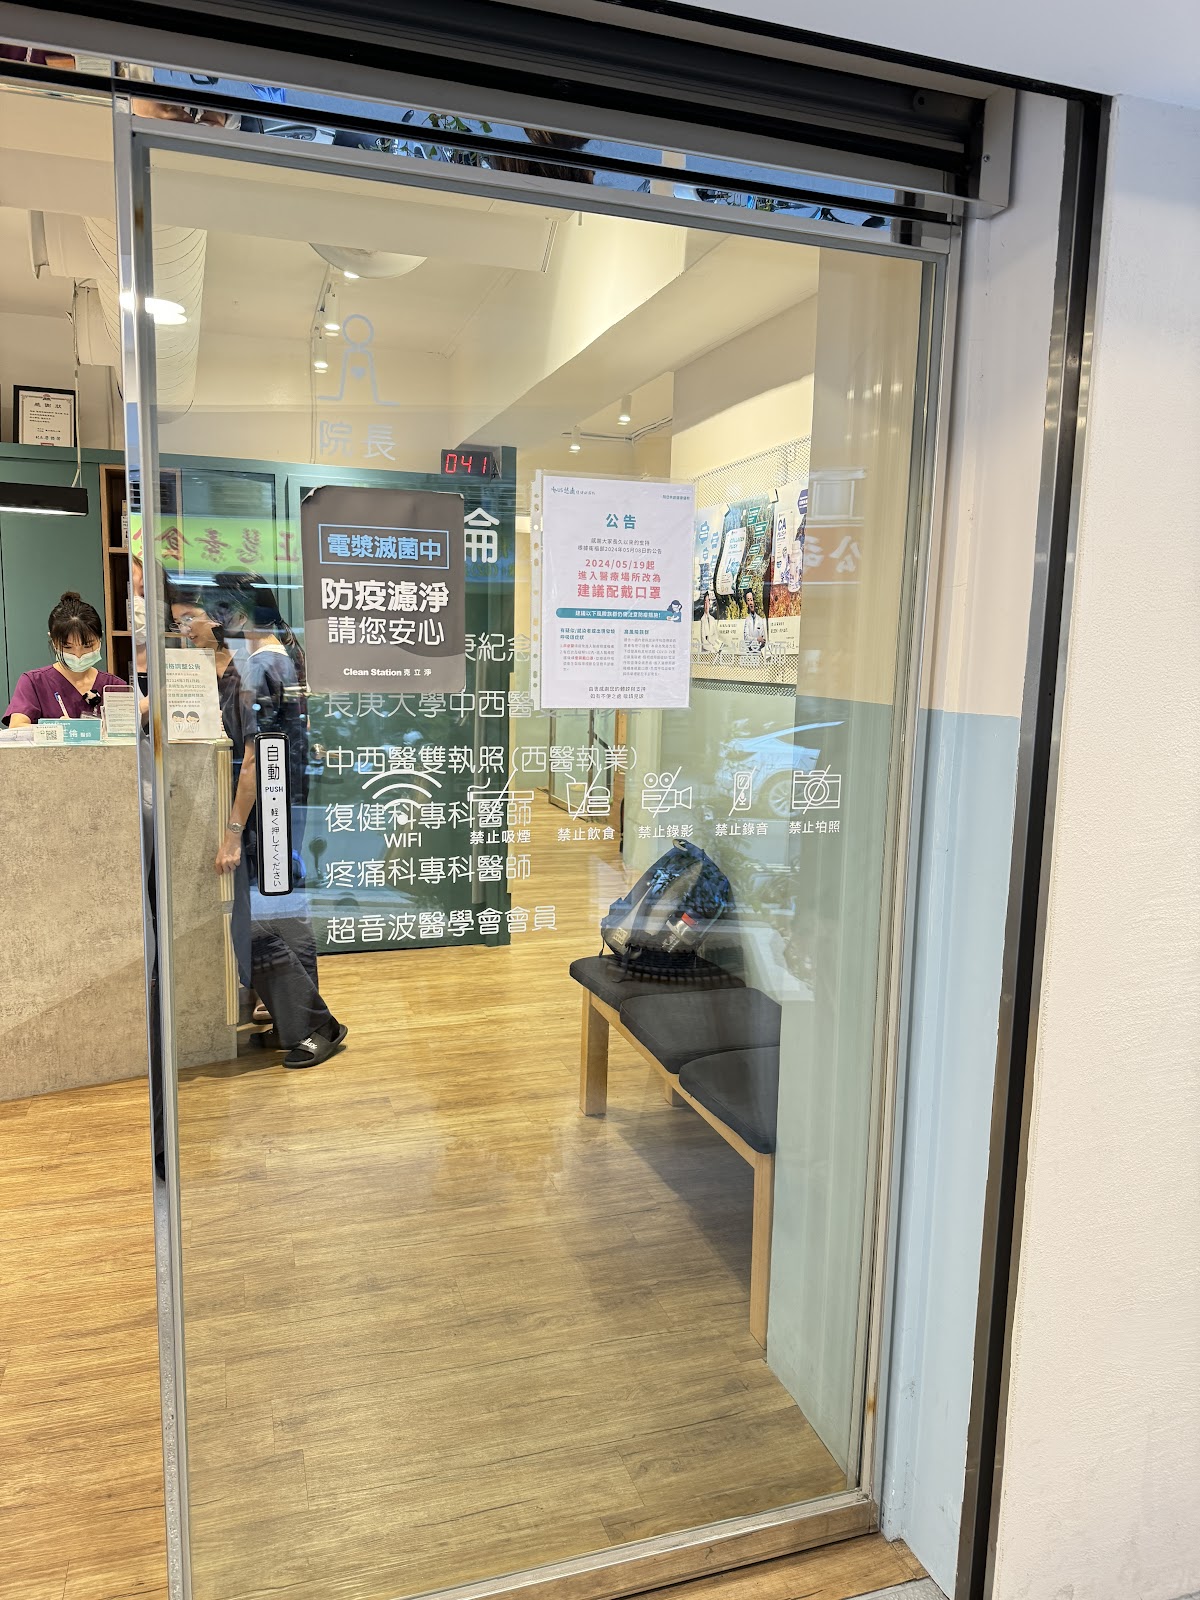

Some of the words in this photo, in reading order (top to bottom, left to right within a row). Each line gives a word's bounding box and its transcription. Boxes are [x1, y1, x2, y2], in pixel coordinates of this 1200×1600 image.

[319, 420, 396, 461] 院長
[445, 453, 488, 474] 041
[605, 513, 637, 530] 公告
[327, 533, 441, 562] 電漿滅菌中
[585, 558, 655, 571] 2024/05/19起
[577, 570, 661, 583] 進入醫療場所改為
[320, 578, 449, 613] 防疫濾淨
[577, 583, 661, 600] 建議配戴口罩
[327, 616, 445, 646] 請您安心
[343, 668, 369, 676] Clean
[370, 668, 402, 677] Station
[267, 744, 280, 781] 自動
[326, 745, 637, 776] 中西醫雙執照(西醫執業)
[325, 799, 532, 834] 復健科專科醫師
[384, 832, 422, 848] WIFI
[469, 829, 532, 845] 禁止吸煙
[557, 826, 616, 842] 禁止飲食
[638, 823, 694, 839] 禁止錄影
[715, 822, 769, 837] 禁止錄音
[271, 807, 282, 887] 軽く押してください
[325, 853, 532, 889] 疼痛科專科醫師
[325, 905, 558, 945] 超音波醫學會會員
